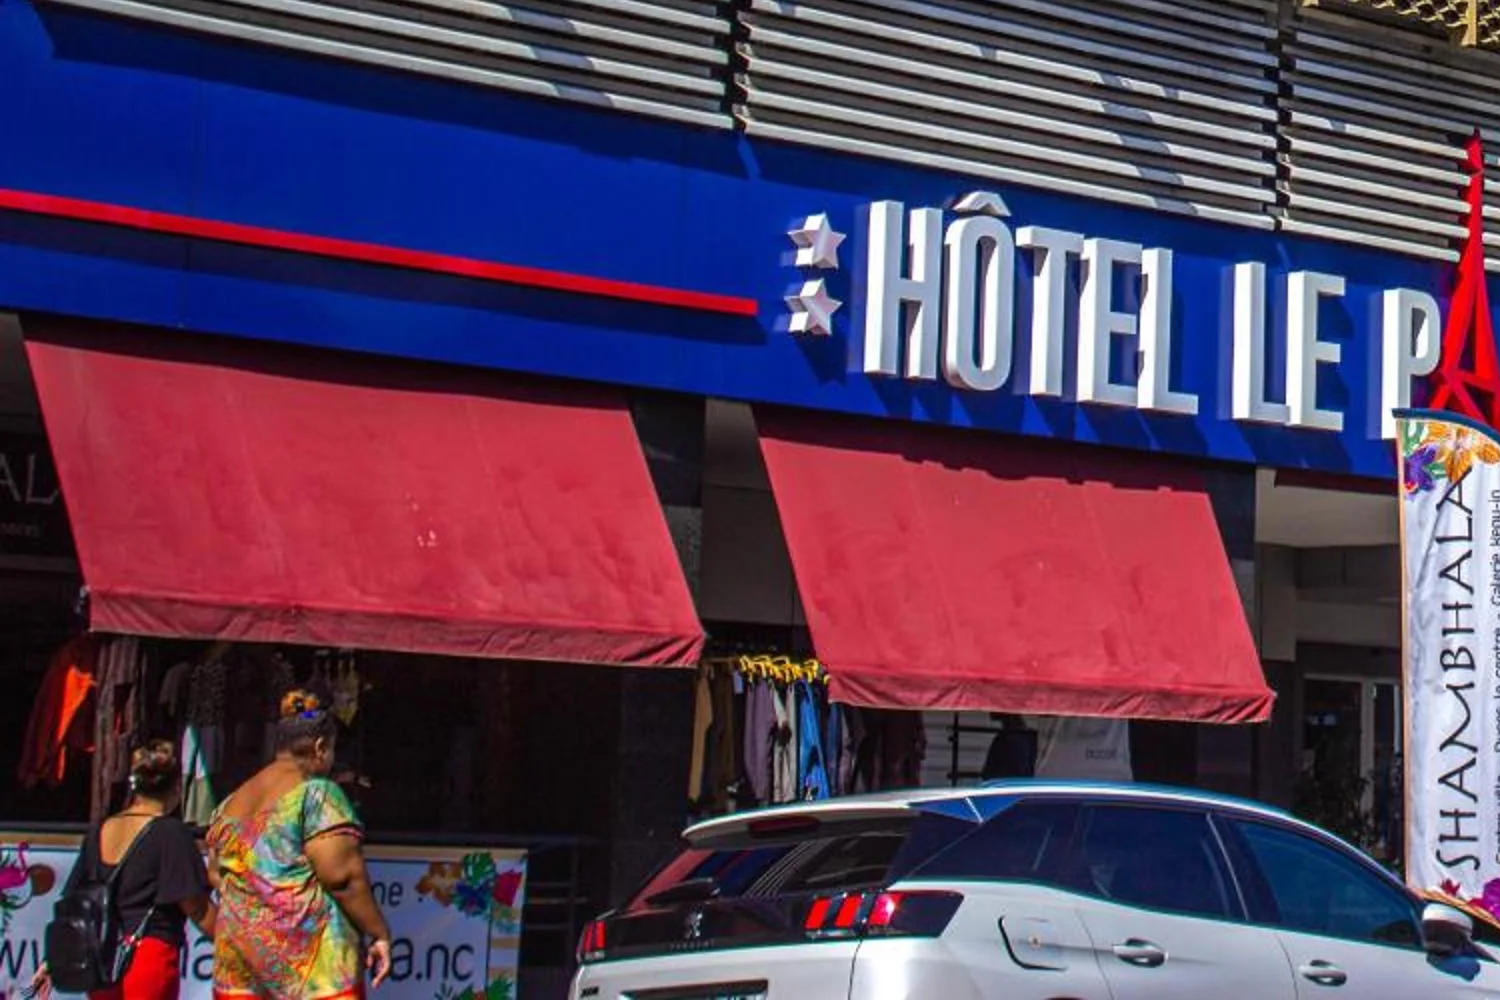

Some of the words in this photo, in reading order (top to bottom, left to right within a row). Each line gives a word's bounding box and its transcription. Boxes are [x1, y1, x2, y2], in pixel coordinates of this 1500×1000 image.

[862, 190, 1199, 416] HÔTEL
[1233, 261, 1346, 431] LE
[1435, 466, 1481, 871] SHAMBHALA
